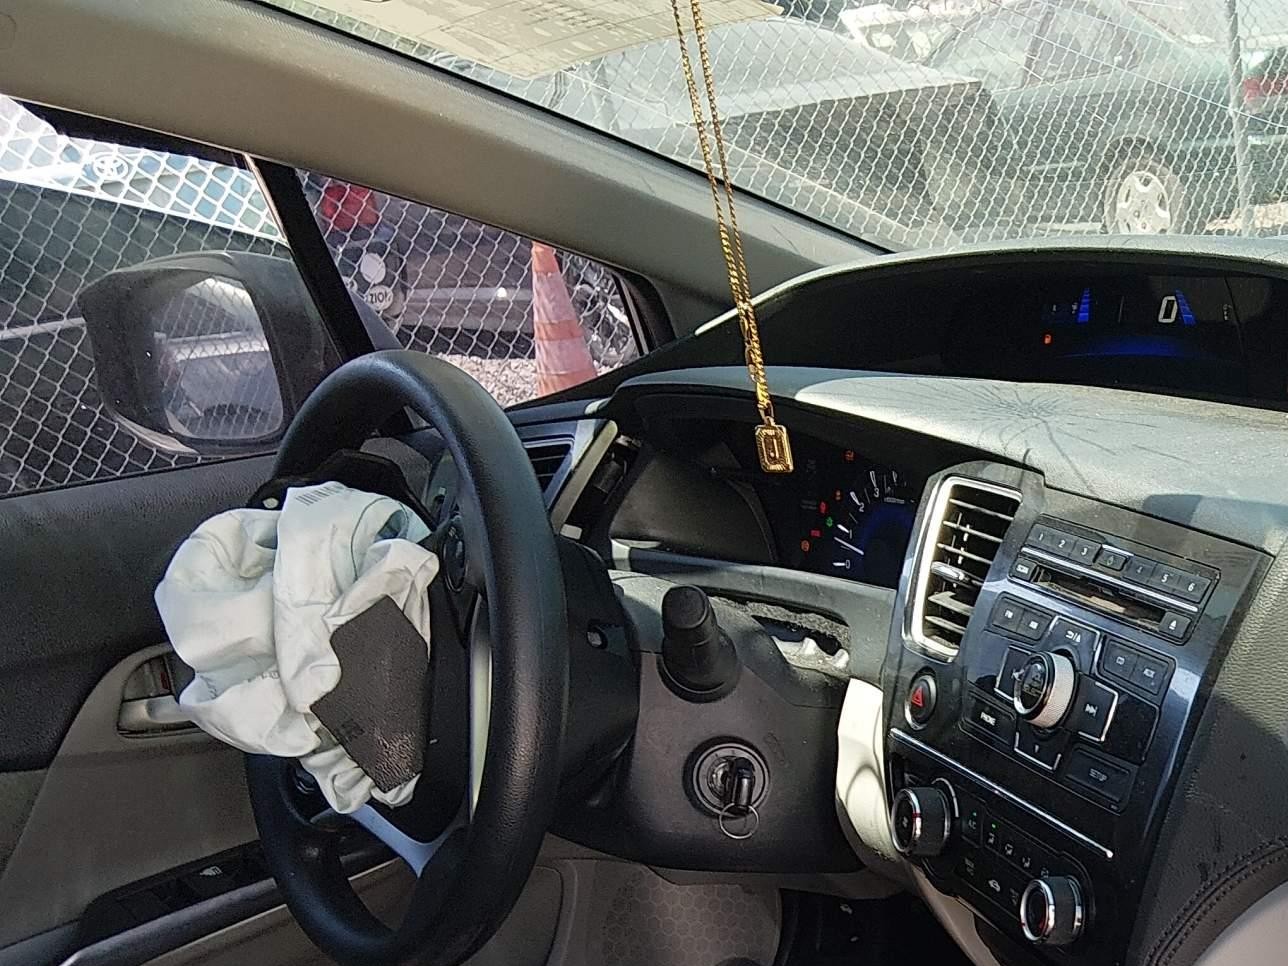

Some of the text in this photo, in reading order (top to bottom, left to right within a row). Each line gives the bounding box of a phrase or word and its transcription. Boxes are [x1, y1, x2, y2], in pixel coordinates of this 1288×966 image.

[1158, 295, 1178, 323] 0
[858, 503, 865, 512] 2
[1058, 539, 1066, 548] 2
[1081, 547, 1088, 556] 3
[1160, 574, 1168, 583] 5
[1187, 582, 1195, 592] 6
